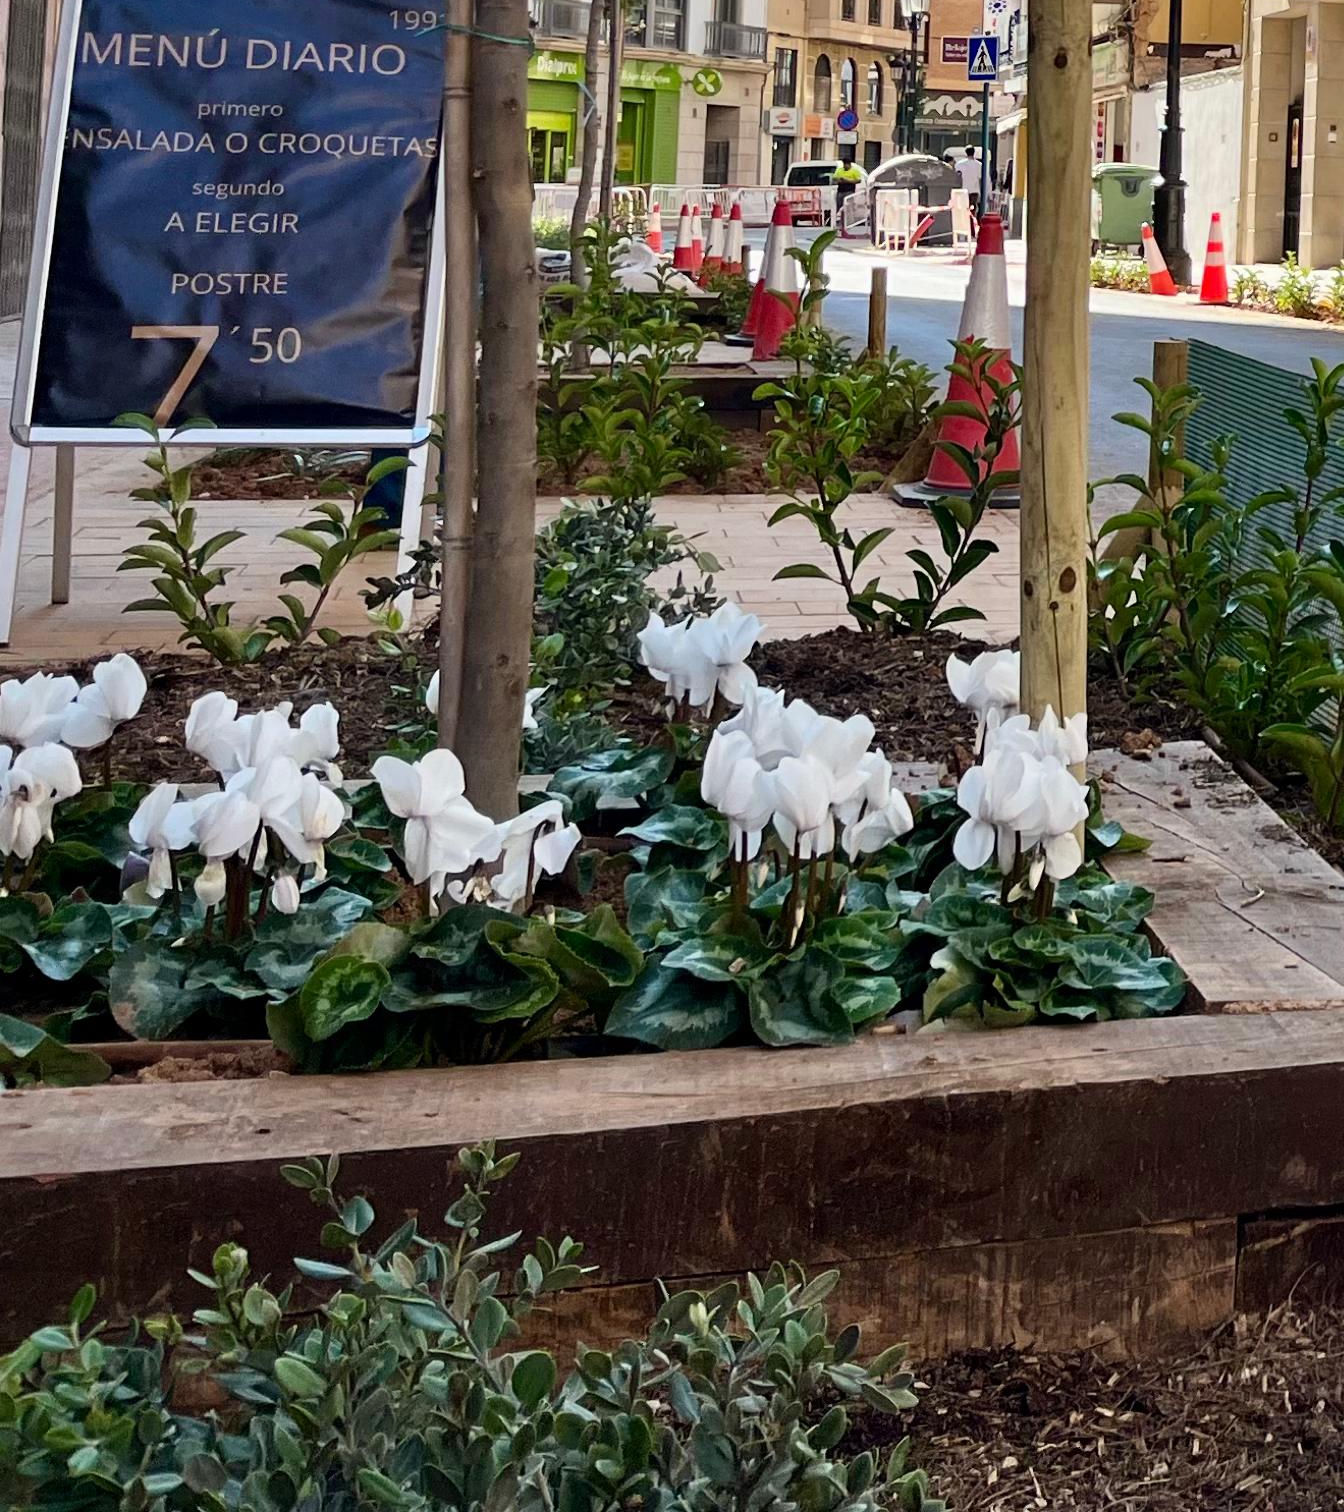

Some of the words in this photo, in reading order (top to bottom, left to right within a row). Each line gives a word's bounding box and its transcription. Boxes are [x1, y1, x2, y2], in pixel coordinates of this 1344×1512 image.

[389, 9, 445, 31] 199
[80, 28, 227, 69] MENÚ
[245, 38, 406, 76] DIARIO
[197, 101, 284, 120] primero
[66, 130, 216, 155] NSALADA
[225, 132, 249, 155] O
[258, 132, 438, 159] CROQUETAS
[192, 180, 285, 200] segundo
[163, 212, 185, 233] A
[195, 212, 299, 234] ELEGIR
[170, 273, 288, 295] POSTRE
